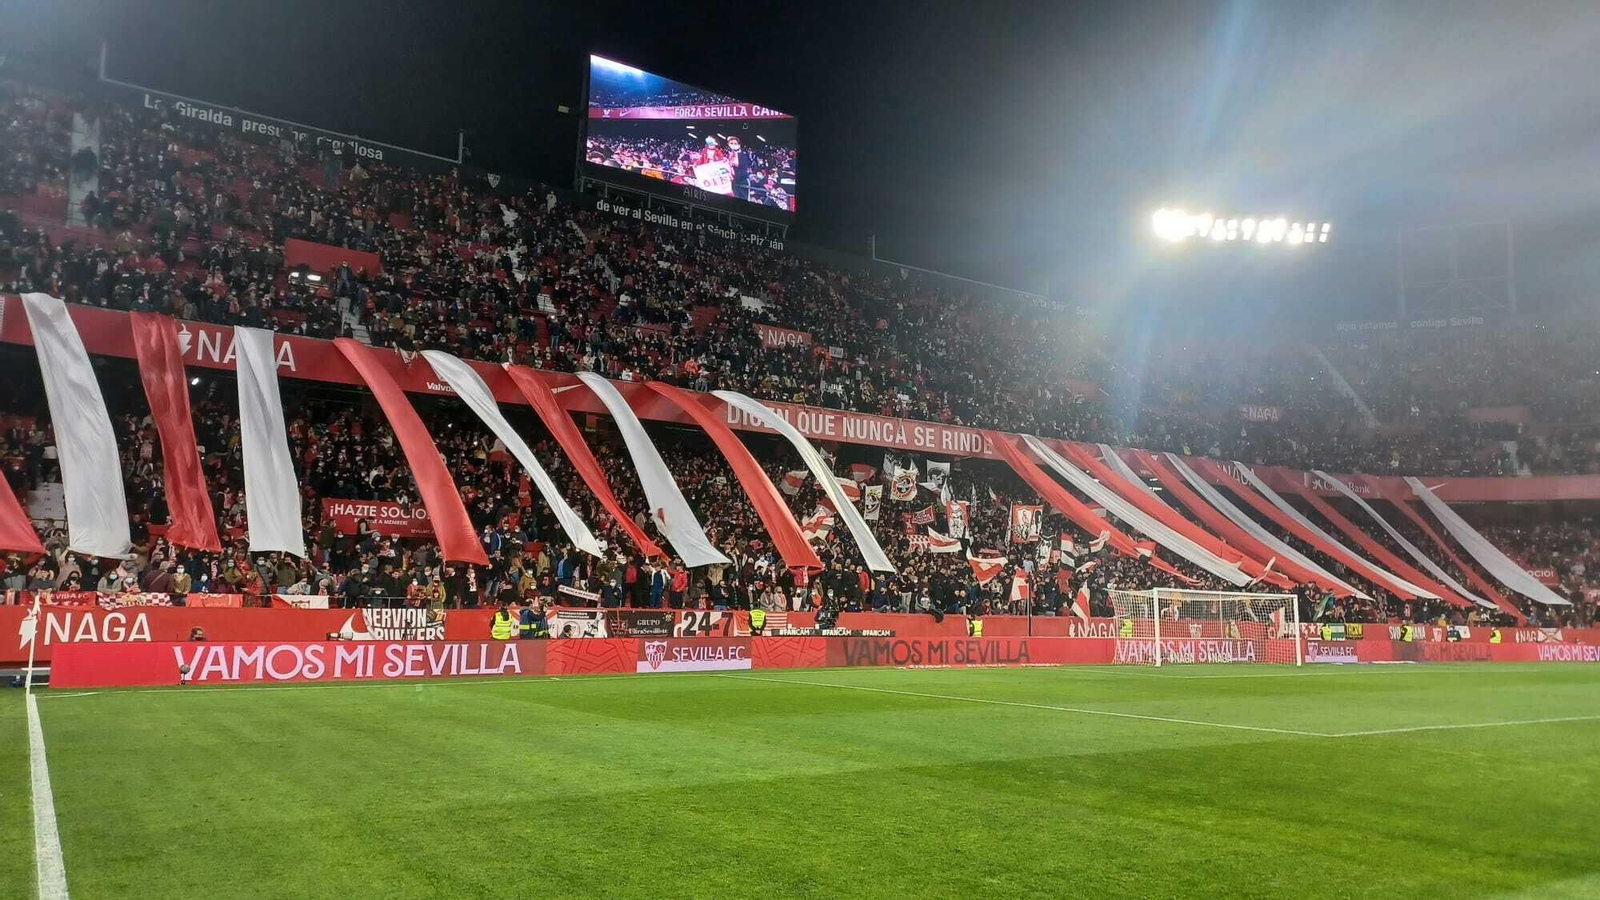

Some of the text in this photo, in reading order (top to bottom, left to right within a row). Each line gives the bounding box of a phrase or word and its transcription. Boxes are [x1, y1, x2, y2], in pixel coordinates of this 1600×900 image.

[144, 94, 161, 109] La
[175, 101, 232, 126] Giralda
[674, 107, 702, 117] FORZA
[704, 105, 748, 117] SEVILLA
[596, 199, 610, 212] de
[612, 204, 630, 216] ver
[632, 208, 641, 220] al
[644, 209, 678, 228] Sevilla
[681, 219, 693, 231] en
[1450, 315, 1485, 327] Sevilla
[768, 329, 804, 348] NAGA
[197, 329, 296, 371] NAA
[1249, 406, 1279, 421] NAGA
[797, 411, 835, 436] QUE
[842, 416, 907, 445] NUNCA
[913, 426, 935, 448] SE
[942, 429, 993, 455] RINDE
[330, 503, 430, 520] ¡HAZTE SOCIO
[44, 612, 152, 646] NAGA
[683, 611, 734, 638] 24-7
[1076, 622, 1115, 639] NAGA
[1519, 630, 1538, 643] NAG
[672, 645, 746, 662] SEVILLA FC
[842, 639, 1030, 666] VAMOS MI SEVILLA
[1199, 640, 1256, 662] SEVILLA
[1320, 646, 1355, 657] SEVILLA FC
[1537, 645, 1570, 661] VAMOS
[171, 643, 522, 681] VAMOS MI SEVILLA
